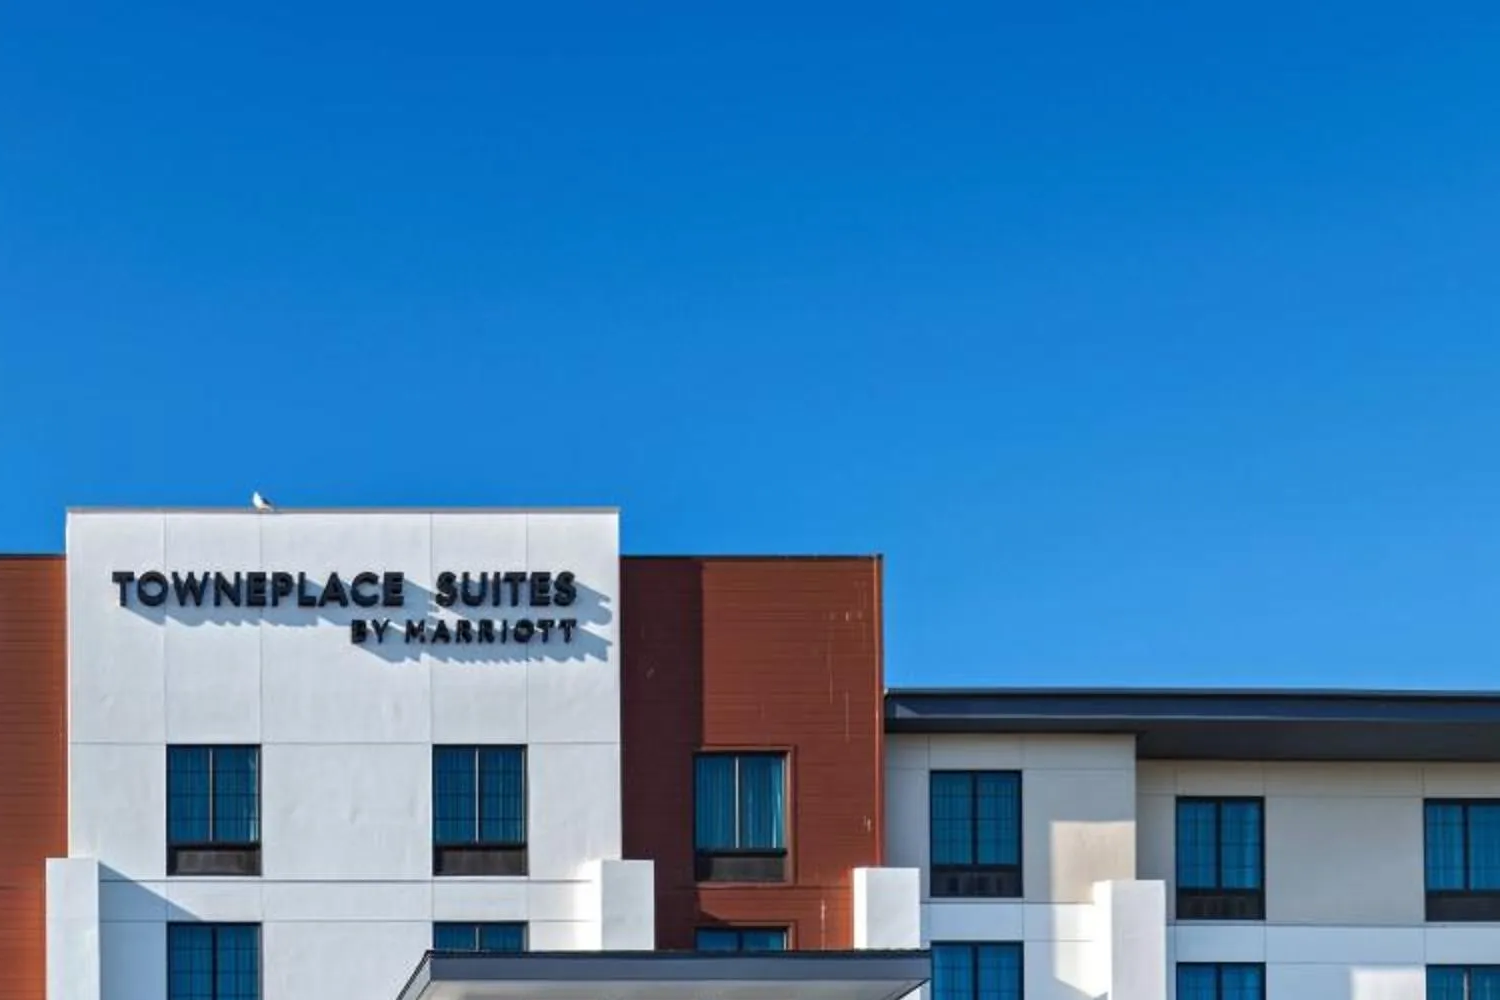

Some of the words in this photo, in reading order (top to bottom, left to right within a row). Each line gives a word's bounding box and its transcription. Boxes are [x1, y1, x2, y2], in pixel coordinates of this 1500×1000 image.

[112, 571, 404, 607] TOWNEPLACE
[435, 571, 577, 607] SUITES
[350, 619, 391, 644] BY
[404, 619, 576, 644] MARRIOTT
